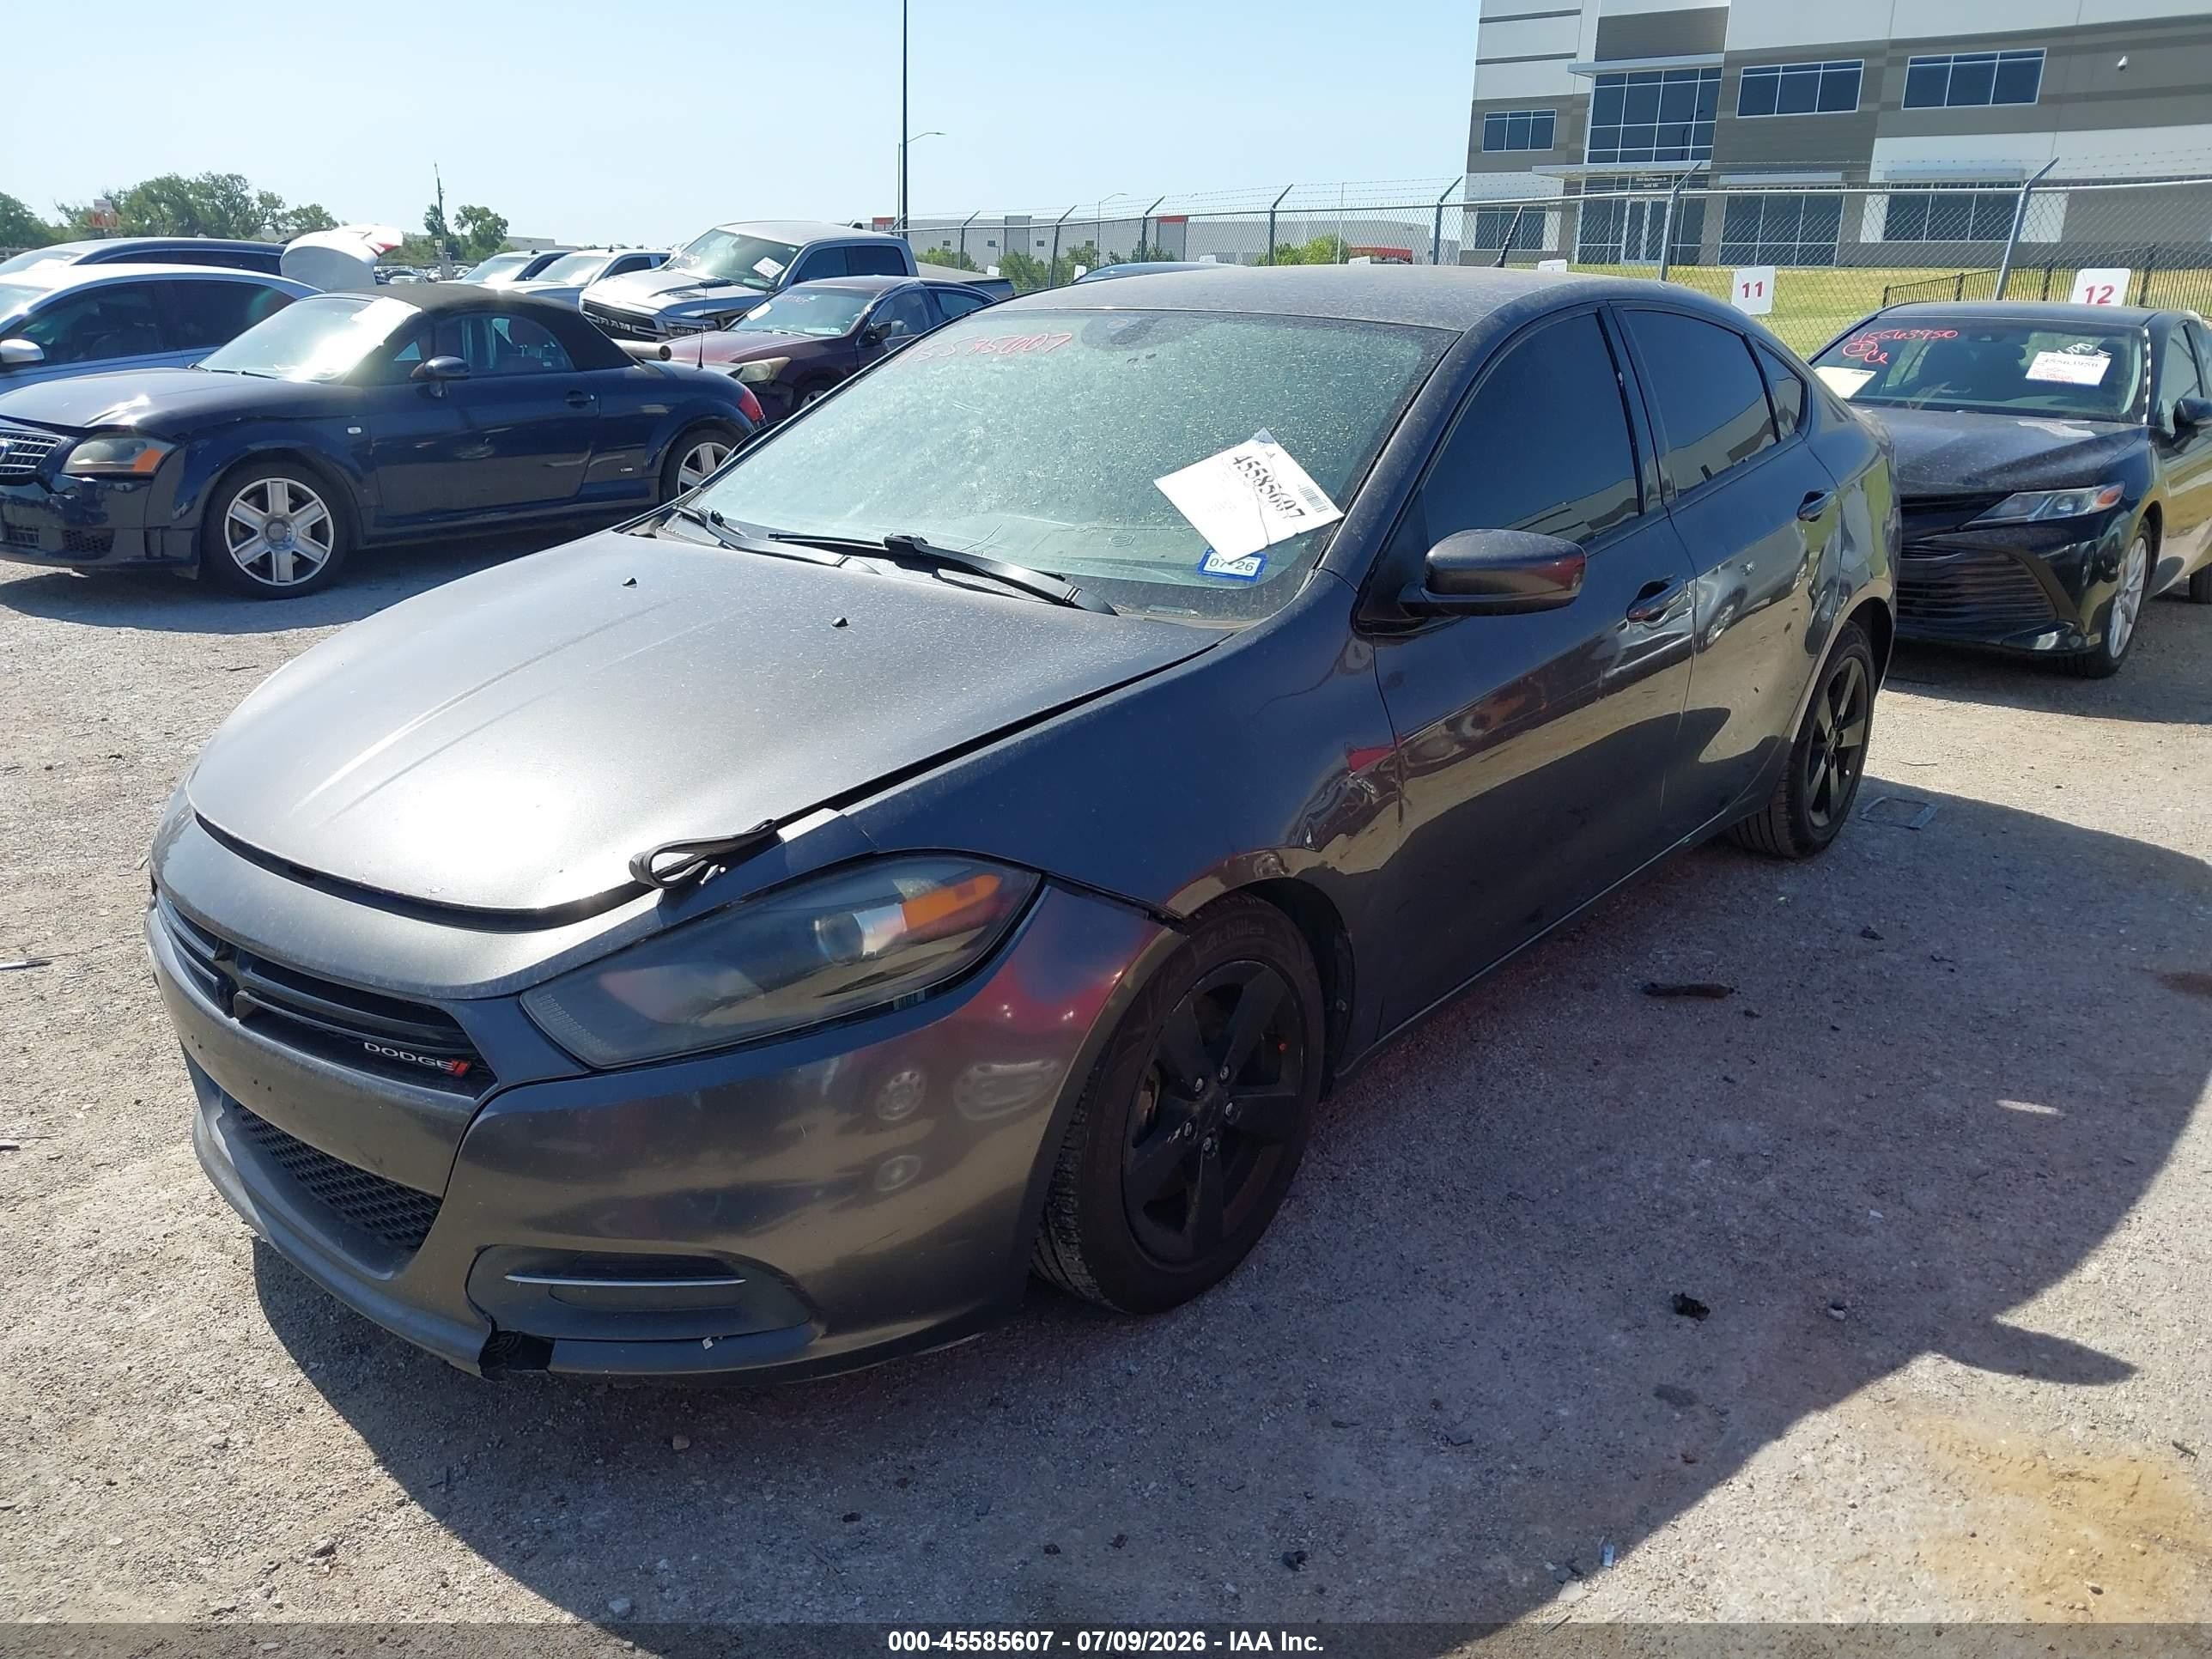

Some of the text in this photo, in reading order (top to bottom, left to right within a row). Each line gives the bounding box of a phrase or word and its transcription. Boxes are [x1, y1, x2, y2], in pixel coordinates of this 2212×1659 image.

[1742, 281, 1763, 298] 11
[2085, 285, 2115, 304] 12
[599, 316, 631, 331] RAM
[1232, 455, 1306, 520] 45585607
[1235, 561, 1255, 571] 26
[1204, 918, 1265, 955] Achilles
[363, 1042, 454, 1071] DODGE
